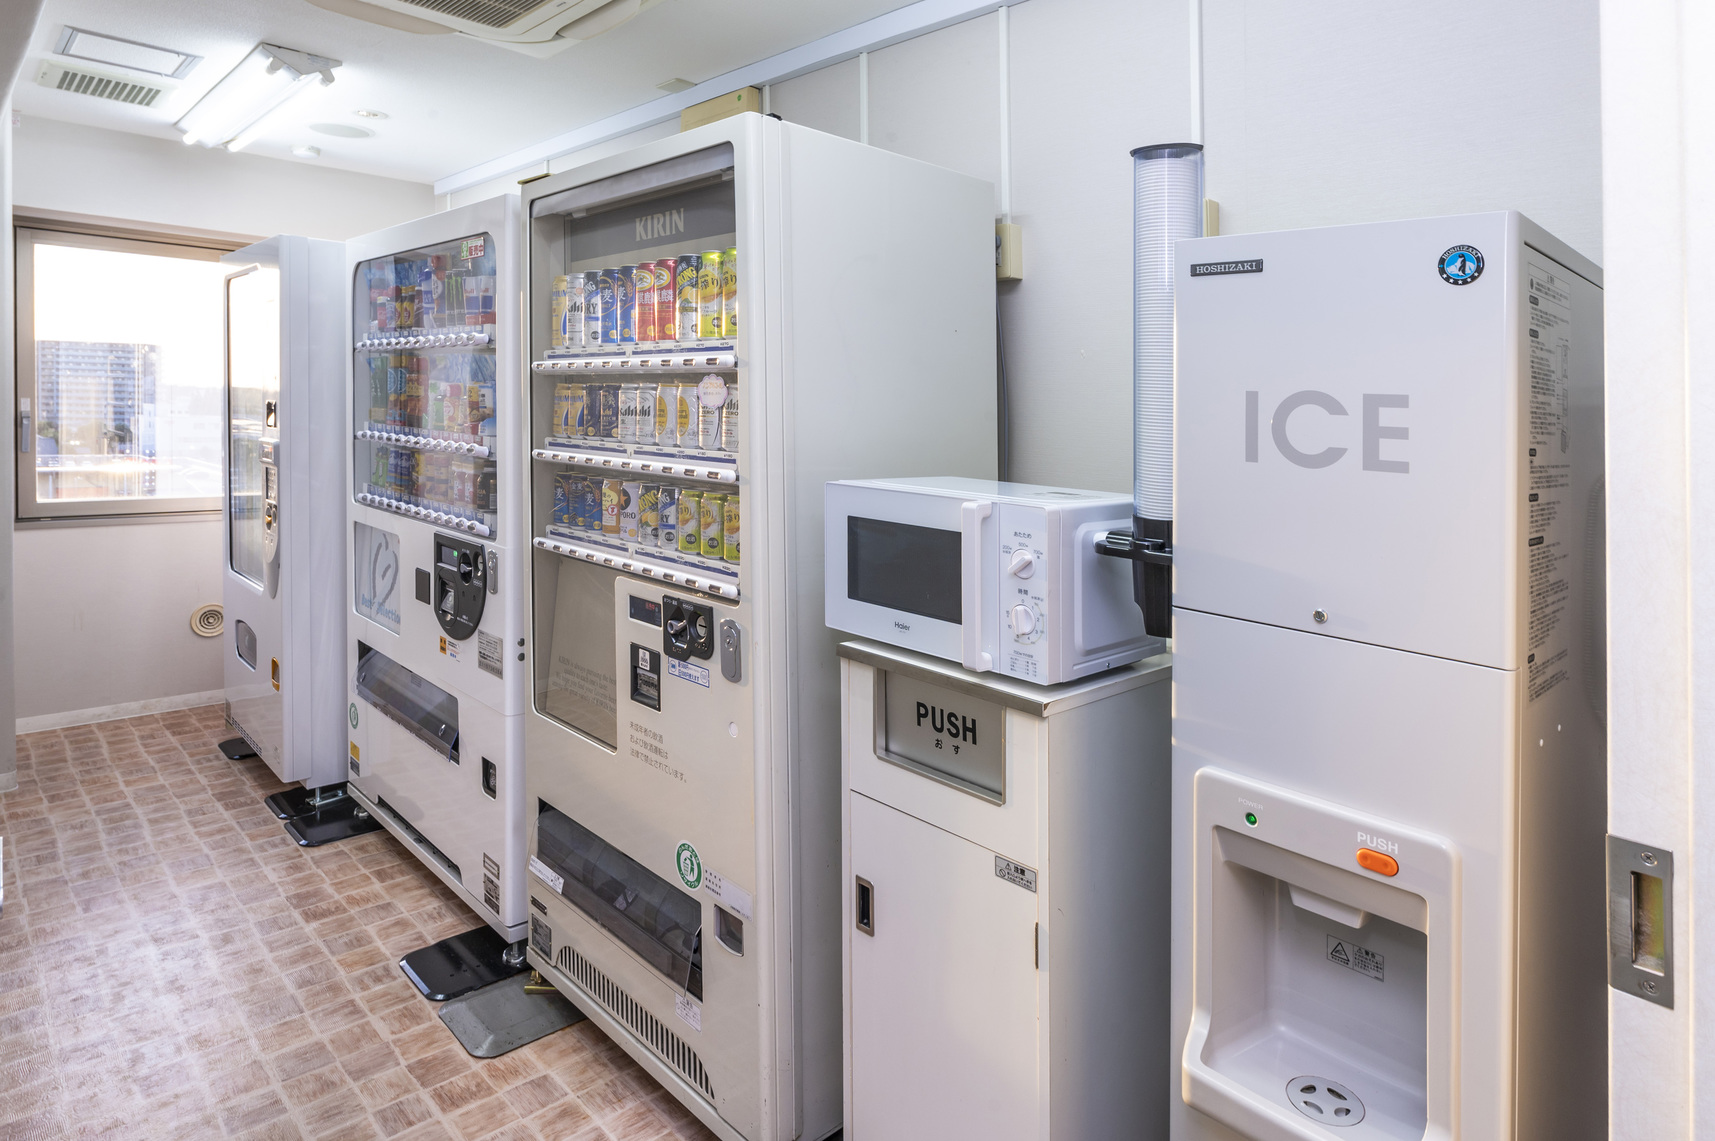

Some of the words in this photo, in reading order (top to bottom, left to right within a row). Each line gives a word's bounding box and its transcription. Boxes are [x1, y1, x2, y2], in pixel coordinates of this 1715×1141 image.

[635, 208, 684, 241] KIRIN
[1442, 245, 1480, 259] HOSHIZAKI
[1196, 262, 1256, 273] HOSHIZAKI
[1245, 389, 1410, 474] ICE
[1014, 531, 1032, 539] あたため
[1018, 588, 1028, 596] 時間
[895, 621, 910, 631] Haier
[630, 721, 664, 744] 未成年者の飲酒
[916, 701, 977, 745] PUSH
[630, 734, 668, 759] および飲酒運転は
[630, 747, 687, 783] 法律で禁止されています。
[1238, 797, 1264, 810] POWER
[1357, 831, 1399, 854] PUSH
